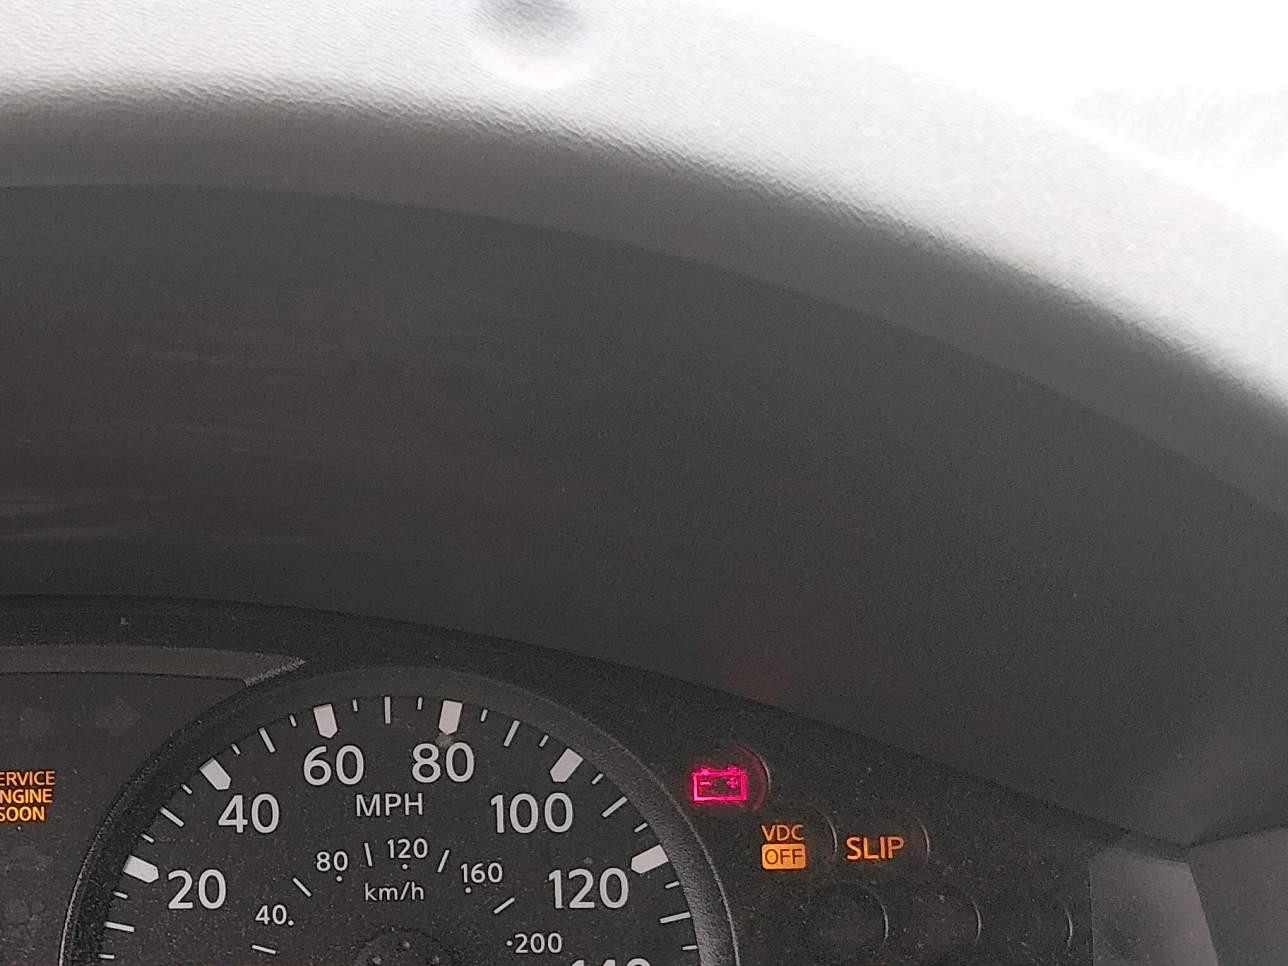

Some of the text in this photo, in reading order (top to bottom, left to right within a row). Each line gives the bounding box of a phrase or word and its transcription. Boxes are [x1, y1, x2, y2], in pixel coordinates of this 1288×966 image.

[304, 746, 363, 785] 60
[413, 743, 474, 782] 80
[219, 794, 279, 834] 40
[356, 792, 424, 817] MPH
[491, 793, 573, 834] 100
[762, 824, 804, 842] VDC
[388, 839, 428, 859] 120
[764, 848, 803, 865] OFF
[846, 836, 905, 861] SLIP
[317, 852, 348, 872] 80
[461, 863, 503, 883] 160
[168, 870, 226, 910] 20
[364, 881, 424, 901] km/h
[549, 868, 628, 909] 120
[256, 905, 287, 925] 40
[515, 933, 563, 954] 200
